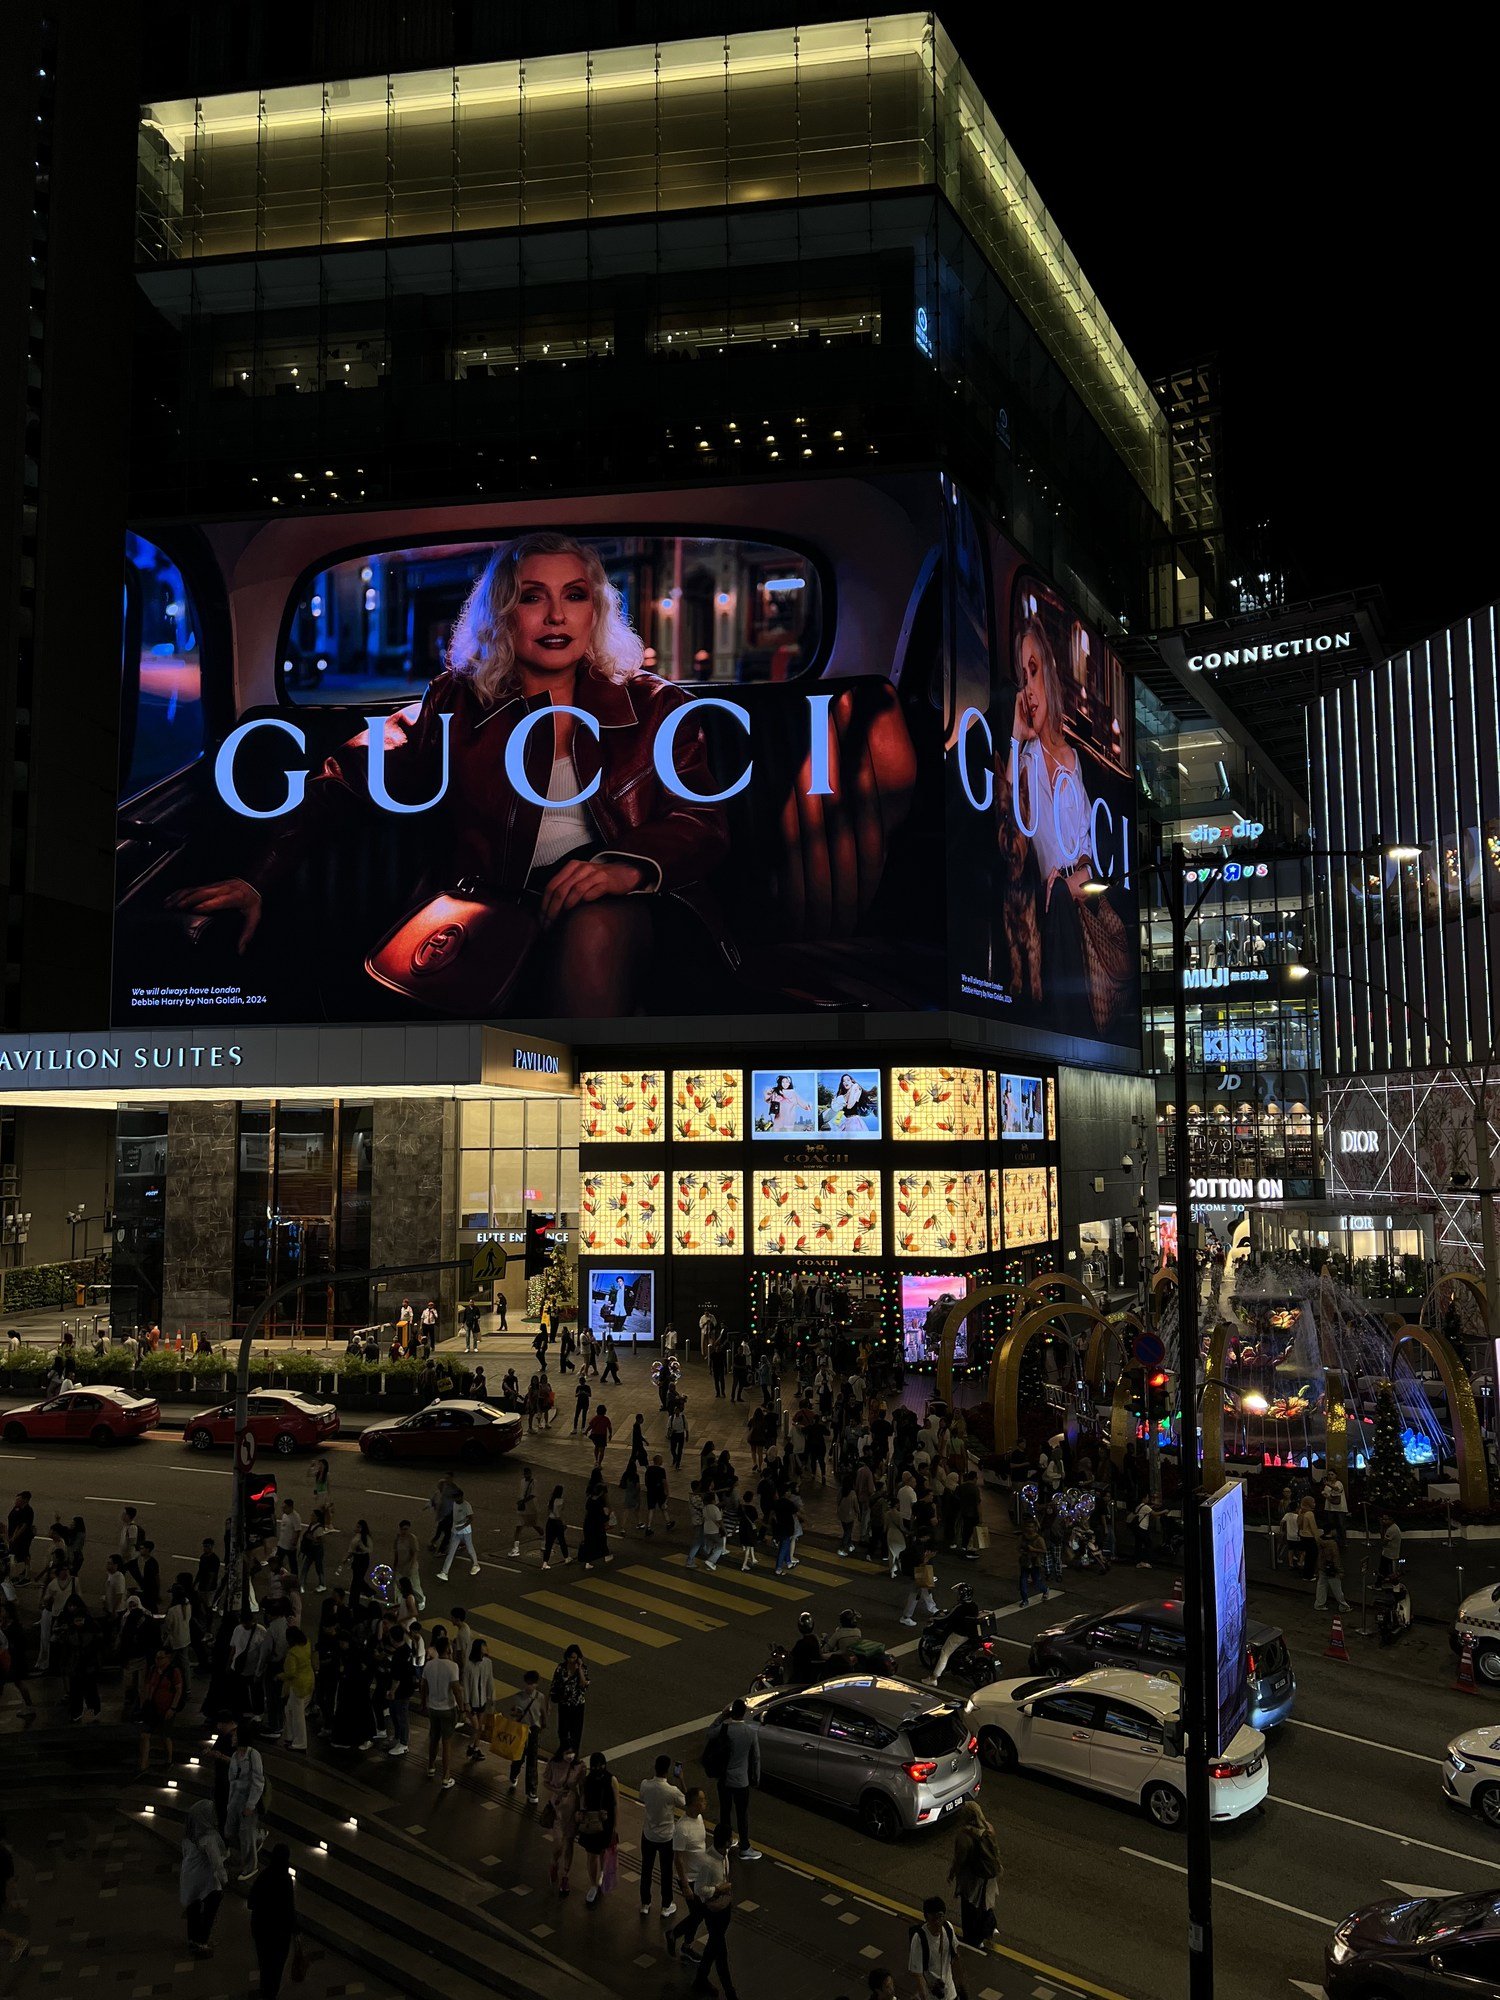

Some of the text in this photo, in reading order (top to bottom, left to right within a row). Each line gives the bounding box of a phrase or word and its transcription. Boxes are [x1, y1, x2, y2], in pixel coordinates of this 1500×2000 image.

[1187, 632, 1351, 672] CONNECTION
[214, 693, 835, 820] GUCCI
[958, 707, 1131, 890] GUCCI
[1183, 967, 1229, 989] MUJI
[131, 996, 267, 1006] Debbie Harry by Nan Goldin, 2024
[146, 987, 160, 995] will
[160, 987, 188, 996] always
[189, 986, 209, 995] have
[211, 986, 241, 994] London
[1204, 1036, 1265, 1054] KING
[134, 1046, 243, 1069] SUITES
[515, 1049, 559, 1074] PAVILION
[1217, 1073, 1242, 1091] JD
[1194, 1135, 1242, 1155] Typo
[1341, 1130, 1379, 1153] DIOR
[784, 1154, 848, 1163] COACH
[1188, 1178, 1284, 1199] COTTON ON
[1190, 1203, 1226, 1212] ELCOME
[477, 1232, 569, 1243] ELITE ENNCE
